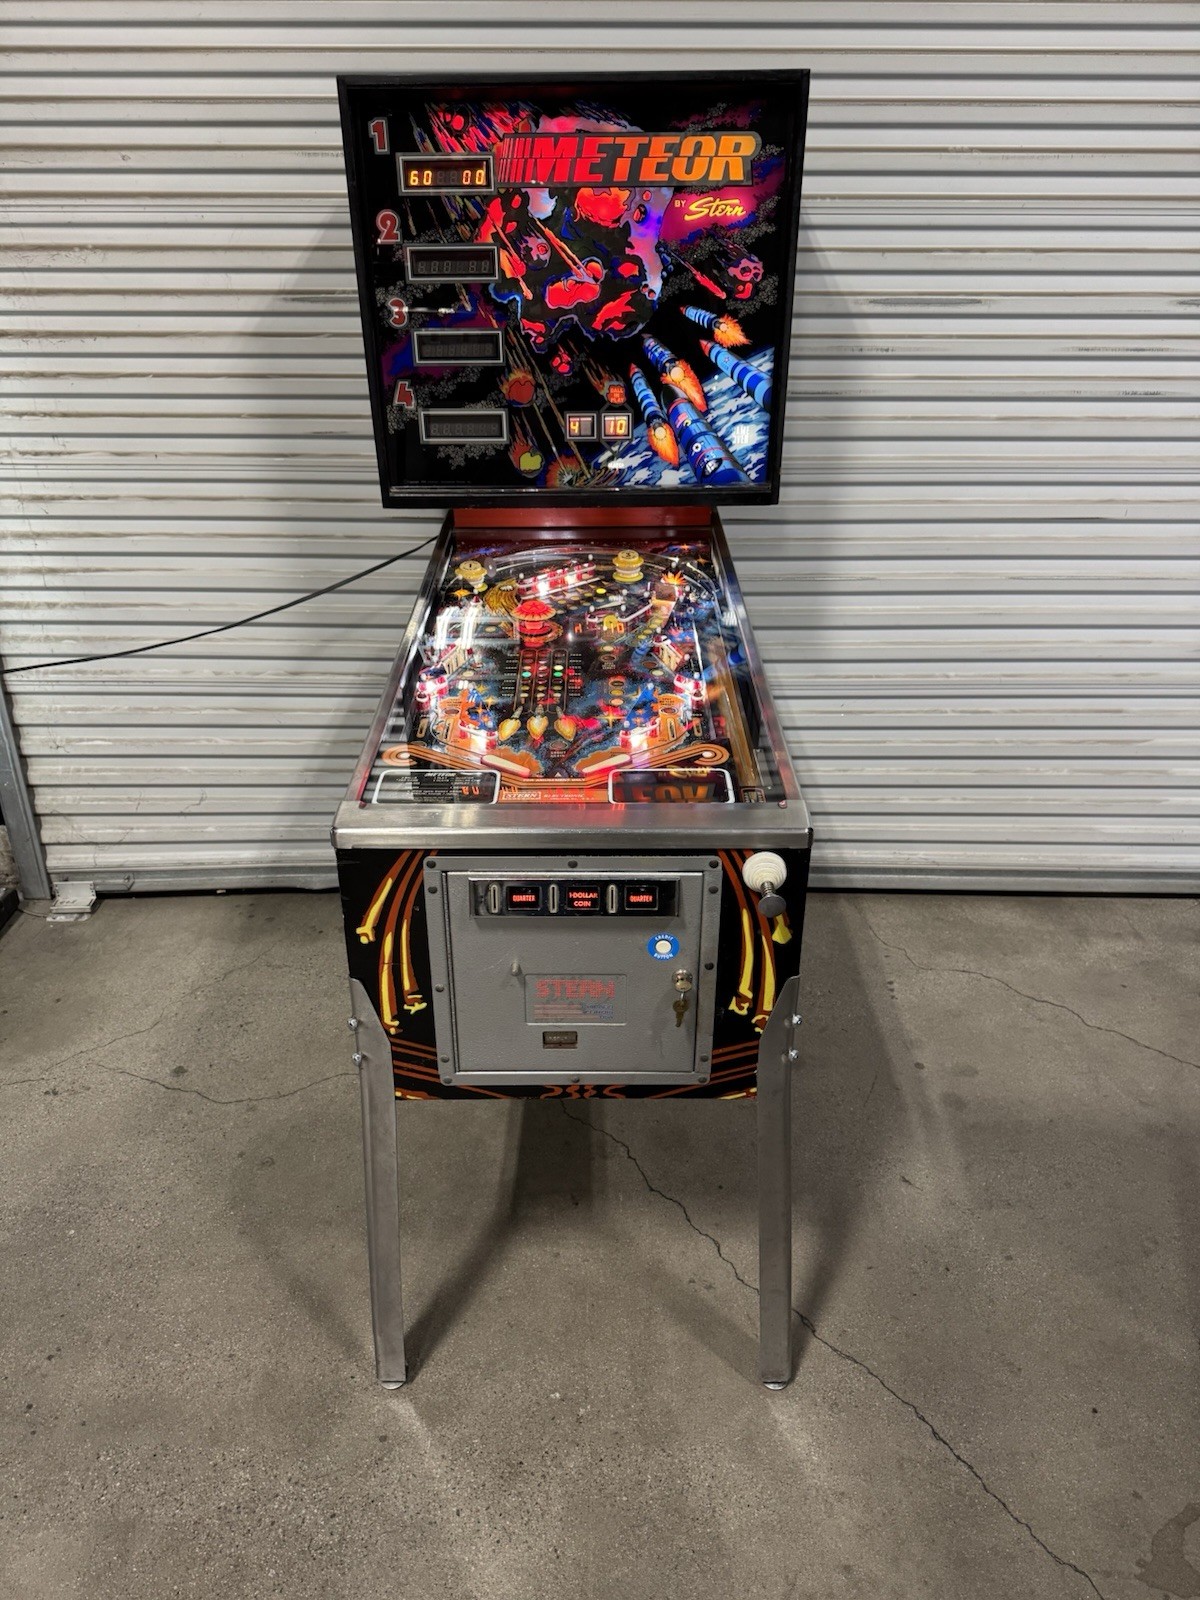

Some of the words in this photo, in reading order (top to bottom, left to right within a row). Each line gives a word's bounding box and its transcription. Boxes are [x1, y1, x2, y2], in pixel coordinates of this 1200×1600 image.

[369, 118, 389, 153] 1
[528, 134, 756, 183] METEOR
[409, 170, 432, 185] 60
[462, 170, 485, 185] 00
[674, 200, 686, 208] BY
[684, 197, 746, 221] Stern
[376, 210, 401, 244] 2
[388, 297, 408, 327] 3
[393, 380, 416, 409] 4
[569, 421, 580, 434] 4
[609, 420, 626, 433] 10
[512, 894, 536, 902] QUARTER
[535, 979, 615, 999] STERN
